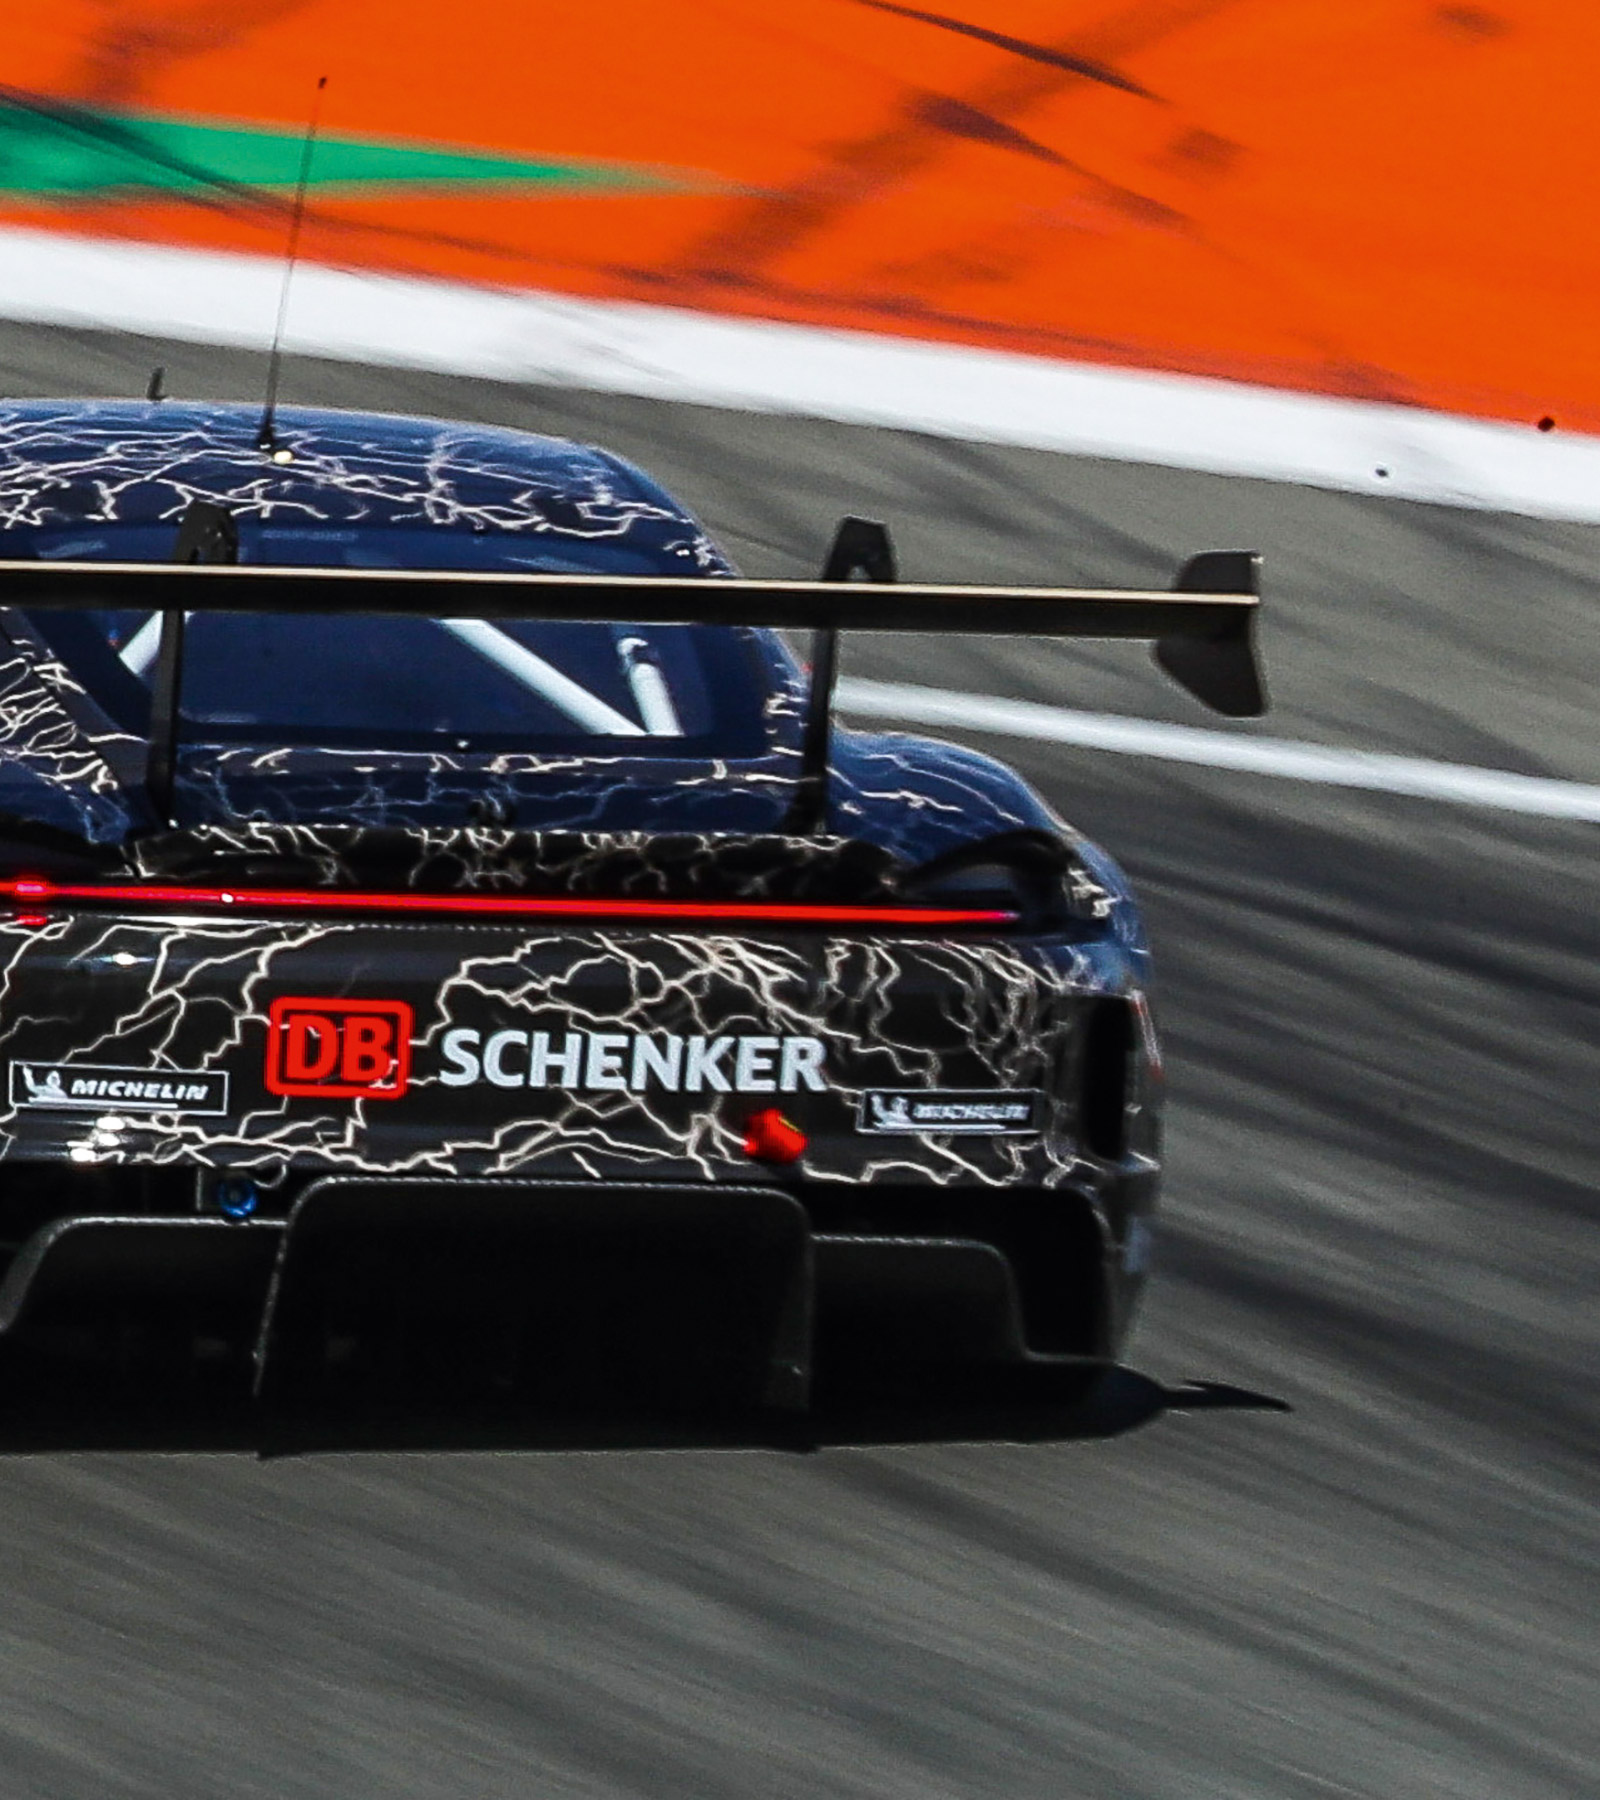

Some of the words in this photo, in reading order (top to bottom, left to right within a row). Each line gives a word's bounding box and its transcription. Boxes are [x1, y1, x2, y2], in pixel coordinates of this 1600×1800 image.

[283, 1013, 395, 1083] DB
[438, 1028, 828, 1093] SCHENKER
[71, 1079, 209, 1100] MICHELIN
